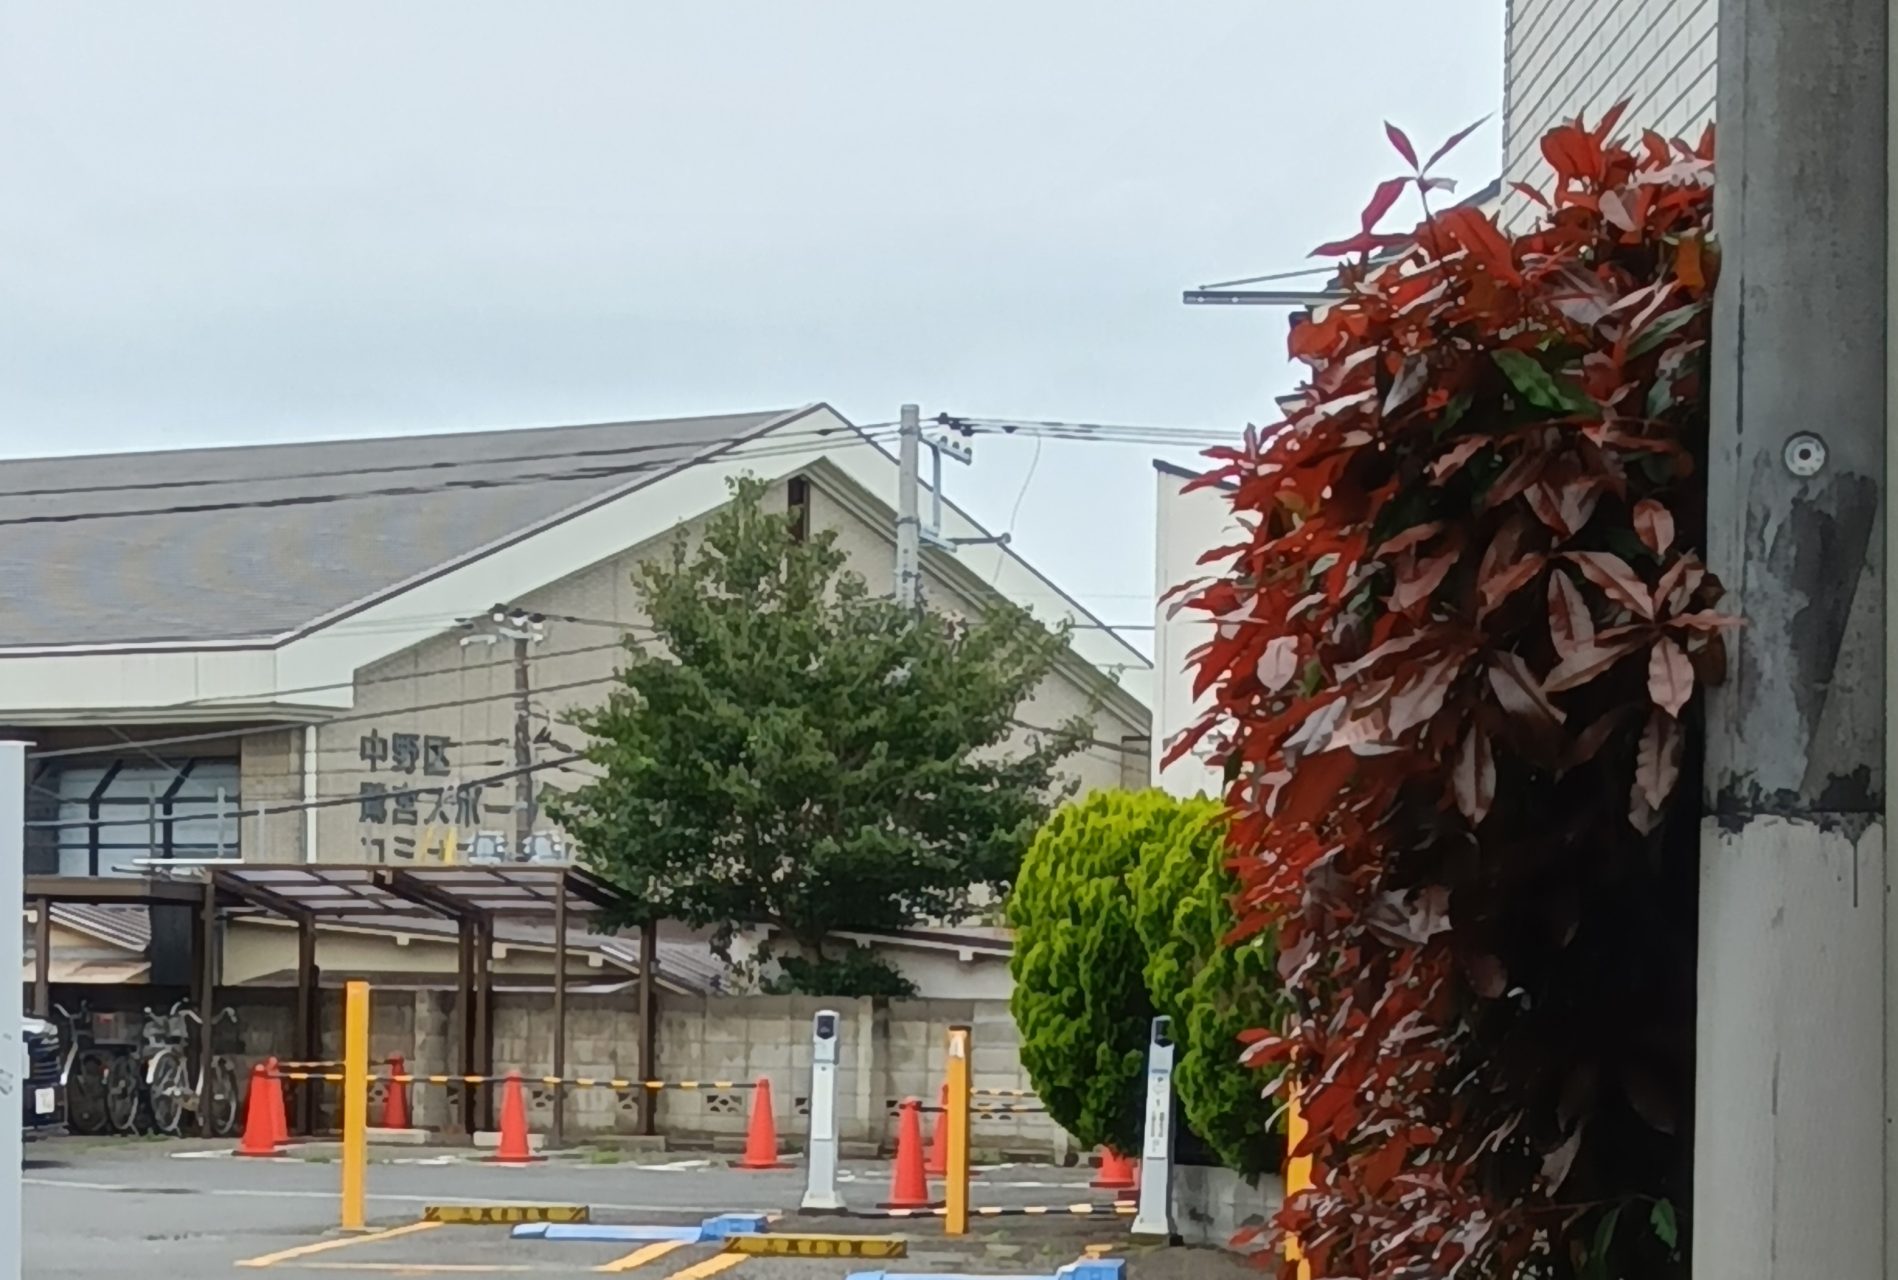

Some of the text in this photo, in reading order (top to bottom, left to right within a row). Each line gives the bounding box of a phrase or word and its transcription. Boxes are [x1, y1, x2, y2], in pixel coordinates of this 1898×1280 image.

[360, 728, 450, 777] 中野区
[359, 781, 538, 828] 鷺宮スポー
